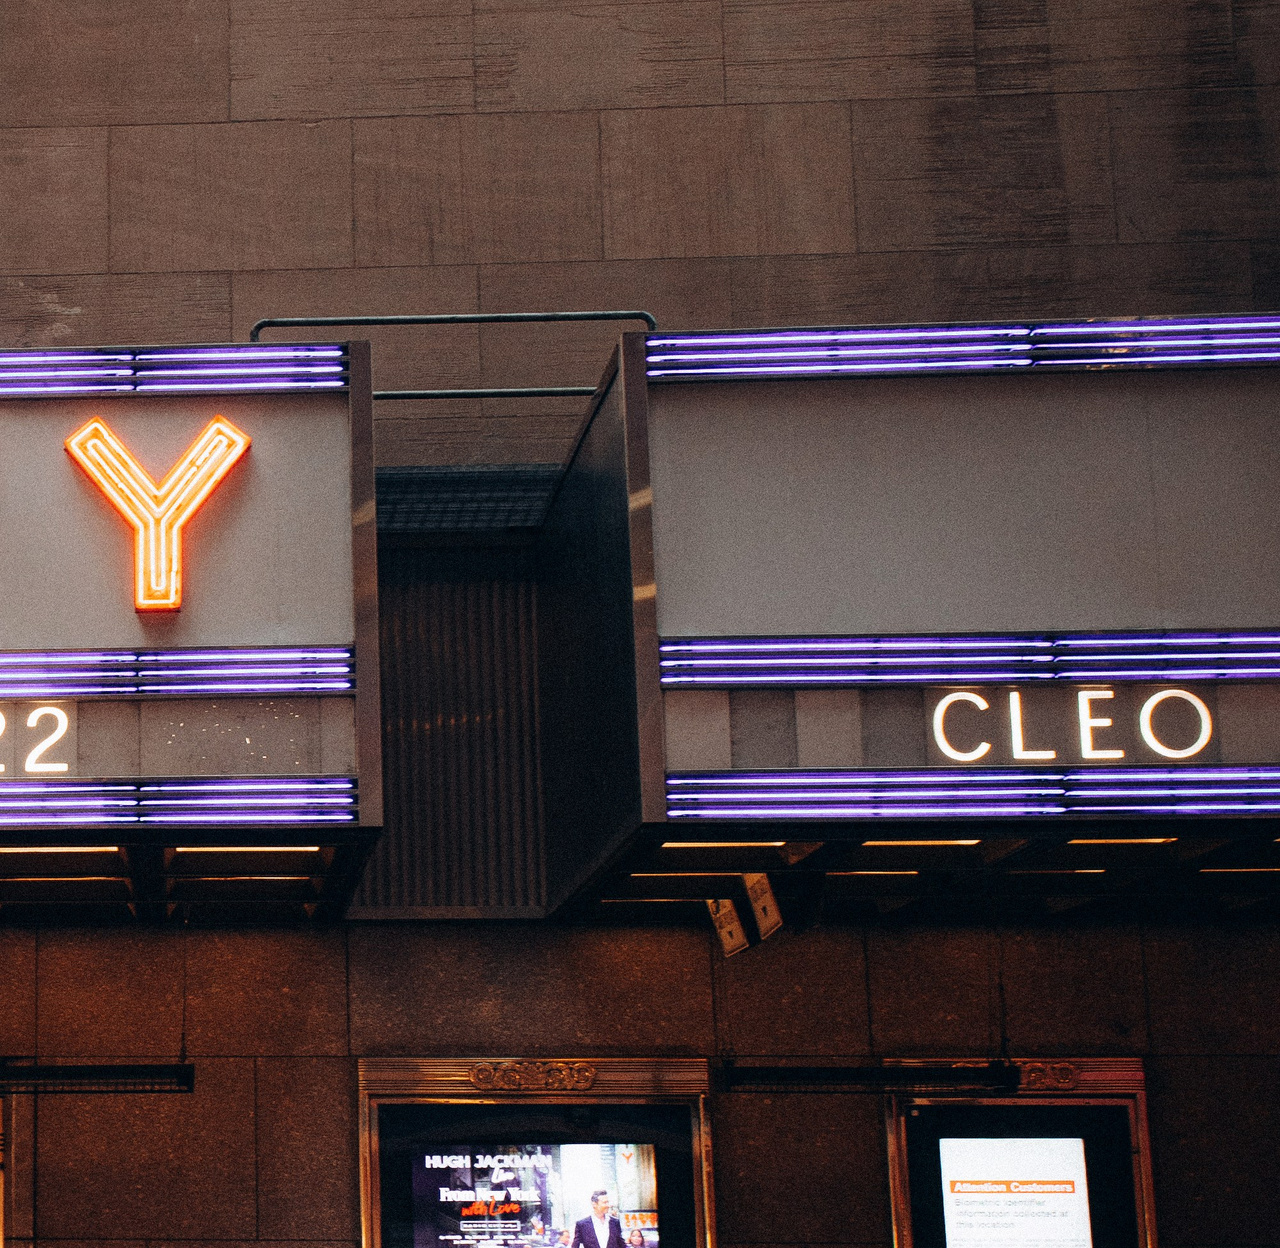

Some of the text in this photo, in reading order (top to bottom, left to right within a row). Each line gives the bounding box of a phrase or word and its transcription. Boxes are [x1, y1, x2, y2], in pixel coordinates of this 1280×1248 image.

[932, 688, 1213, 762] CLEO
[425, 1154, 552, 1168] HUGH JACKMAN
[954, 1182, 1073, 1192] Attention Customers
